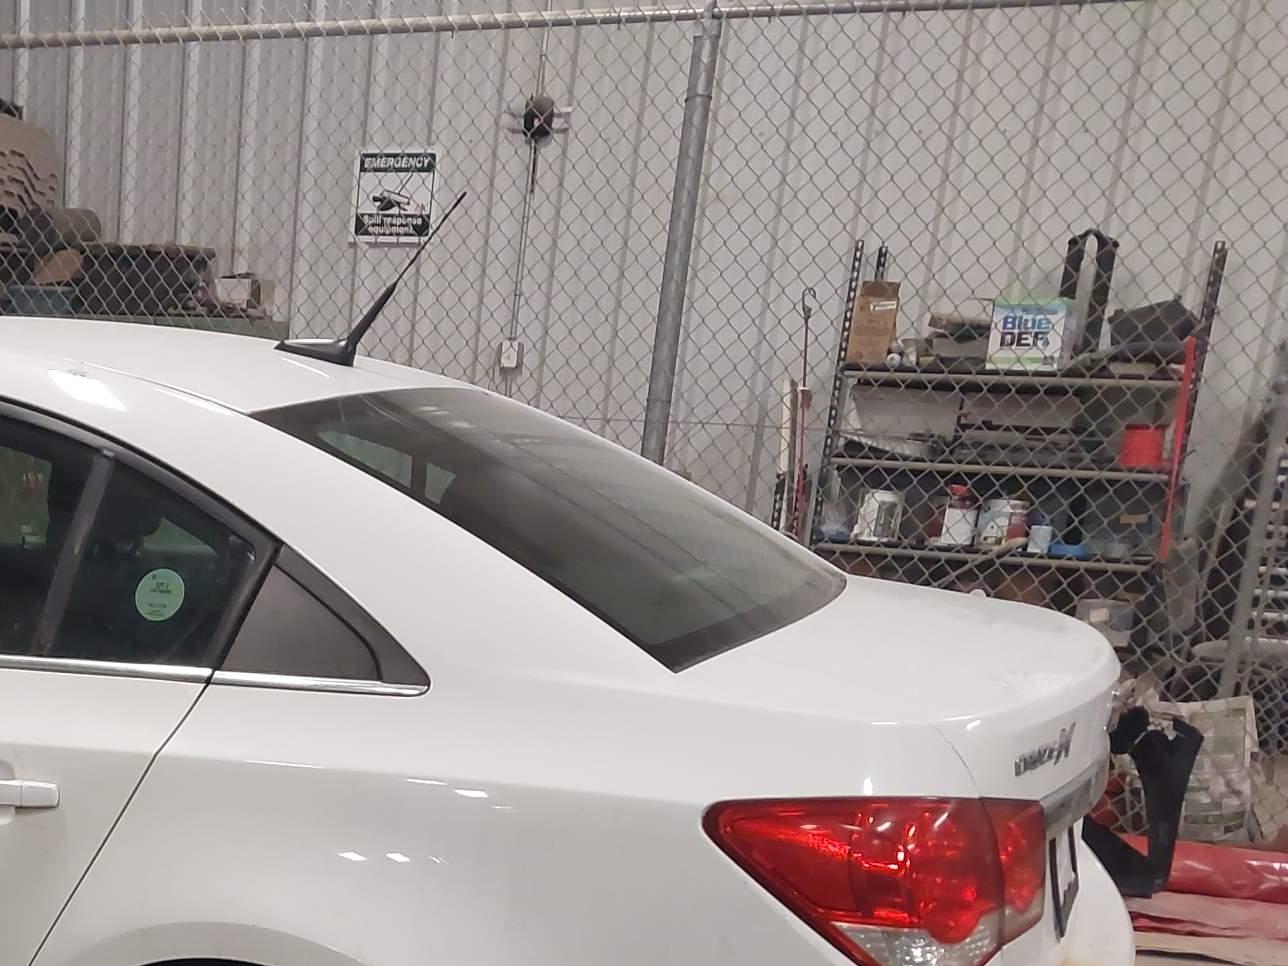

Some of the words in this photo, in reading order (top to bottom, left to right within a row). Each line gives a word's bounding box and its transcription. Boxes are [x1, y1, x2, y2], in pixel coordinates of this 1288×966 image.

[364, 157, 430, 169] EMERGENCY
[1002, 315, 1050, 330] Blue
[1000, 331, 1049, 347] DEF
